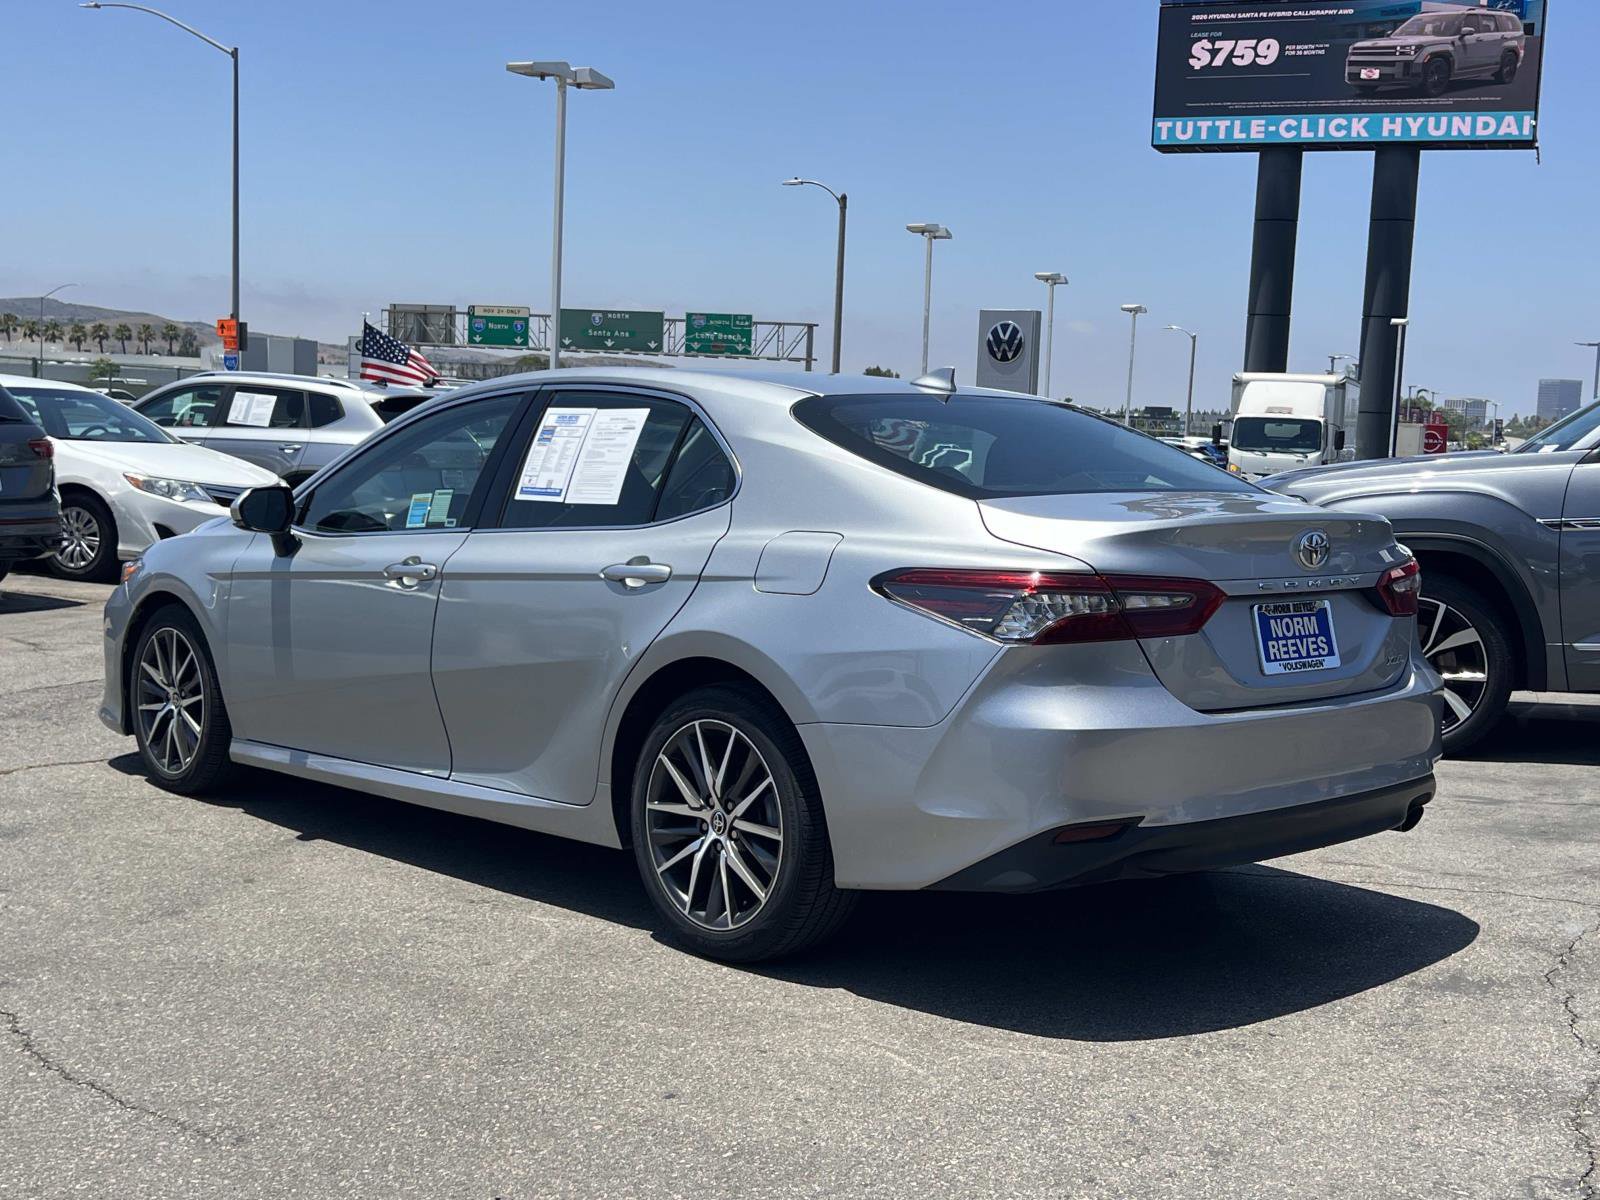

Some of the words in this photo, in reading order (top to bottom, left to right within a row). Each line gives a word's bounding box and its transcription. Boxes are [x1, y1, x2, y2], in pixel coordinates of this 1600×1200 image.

[1188, 38, 1280, 70] $759
[1157, 117, 1370, 140] TUTTLE-CLICK
[1381, 115, 1531, 137] HYUNDAI
[588, 329, 611, 337] Santa
[613, 329, 630, 338] Ana
[1259, 577, 1360, 591] CAMRY
[1269, 616, 1319, 638] NORM
[1267, 636, 1329, 660] REEVES
